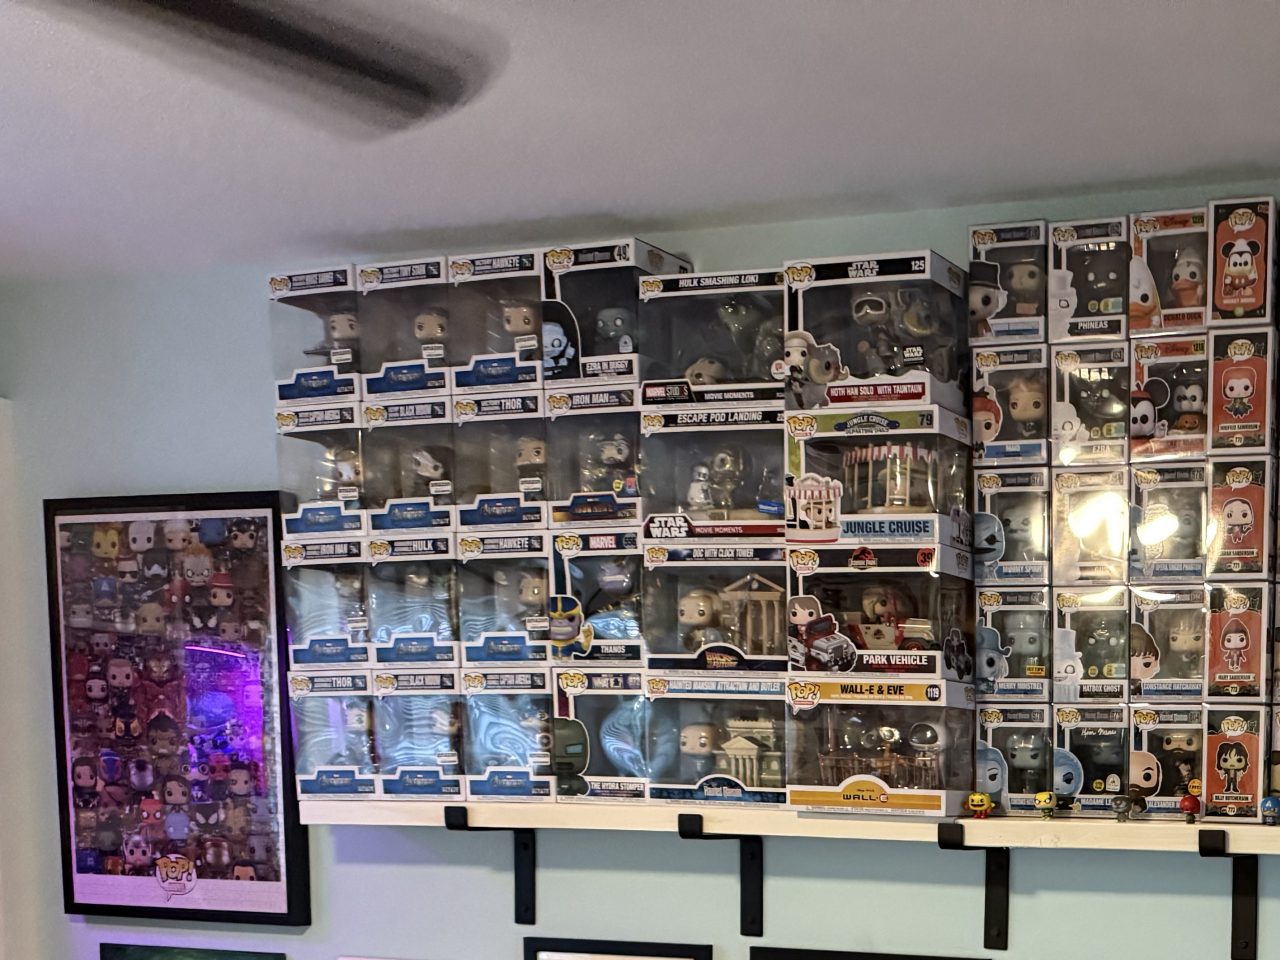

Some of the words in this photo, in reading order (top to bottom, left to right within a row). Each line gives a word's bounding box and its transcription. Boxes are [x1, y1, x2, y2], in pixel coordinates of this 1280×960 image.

[850, 260, 879, 269] STAR
[911, 260, 925, 271] 125
[786, 265, 814, 283] POP!
[848, 268, 880, 278] WARS
[679, 278, 698, 288] HULK
[699, 276, 739, 287] SMASHING
[740, 275, 758, 284] LOKI
[1078, 322, 1108, 330] PHINEAS
[724, 391, 754, 400] MOMENTS
[859, 386, 874, 396] SOLO
[876, 386, 890, 395] WITH
[892, 384, 922, 394] TAUNTAUN
[501, 398, 522, 410] THOR
[572, 395, 590, 406] IRON
[592, 394, 609, 404] MAN
[678, 414, 708, 424] ESCAPE
[710, 412, 723, 422] POD
[724, 411, 762, 422] LANDING
[918, 412, 934, 426] 79
[788, 416, 816, 433] POP!
[650, 516, 685, 527] STAR
[843, 521, 882, 535] JUNGLE
[884, 520, 930, 534] CRUISE
[650, 526, 689, 538] WARS
[696, 526, 715, 534] MOVIE
[716, 526, 744, 534] MOMENTS
[412, 540, 433, 550] HULK
[500, 538, 528, 548] HAWKEYE
[556, 534, 581, 550] POP!
[588, 536, 616, 548] MARVEL
[790, 552, 818, 569] POP!
[921, 552, 933, 564] 39
[863, 655, 890, 666] PARK
[892, 655, 928, 666] VEHICLE
[332, 678, 352, 688] THOR
[559, 672, 586, 688] POP!
[669, 681, 693, 691] HAUNTED
[694, 682, 716, 691] MANSION
[718, 682, 748, 692] ATTRACTION
[750, 682, 760, 691] AND
[762, 682, 780, 692] BUTLER
[788, 682, 820, 703] POP!
[840, 684, 874, 696] WALL-E
[876, 686, 884, 695] &
[886, 685, 904, 695] EVE
[1082, 684, 1102, 693] HATBOX
[1103, 684, 1121, 693] GHOST
[926, 688, 940, 698] 1119
[981, 710, 1003, 724] POP!
[1057, 709, 1081, 724] POP!
[1134, 710, 1160, 725] POP!
[1222, 720, 1246, 733] POP!
[155, 856, 194, 883] POP!
